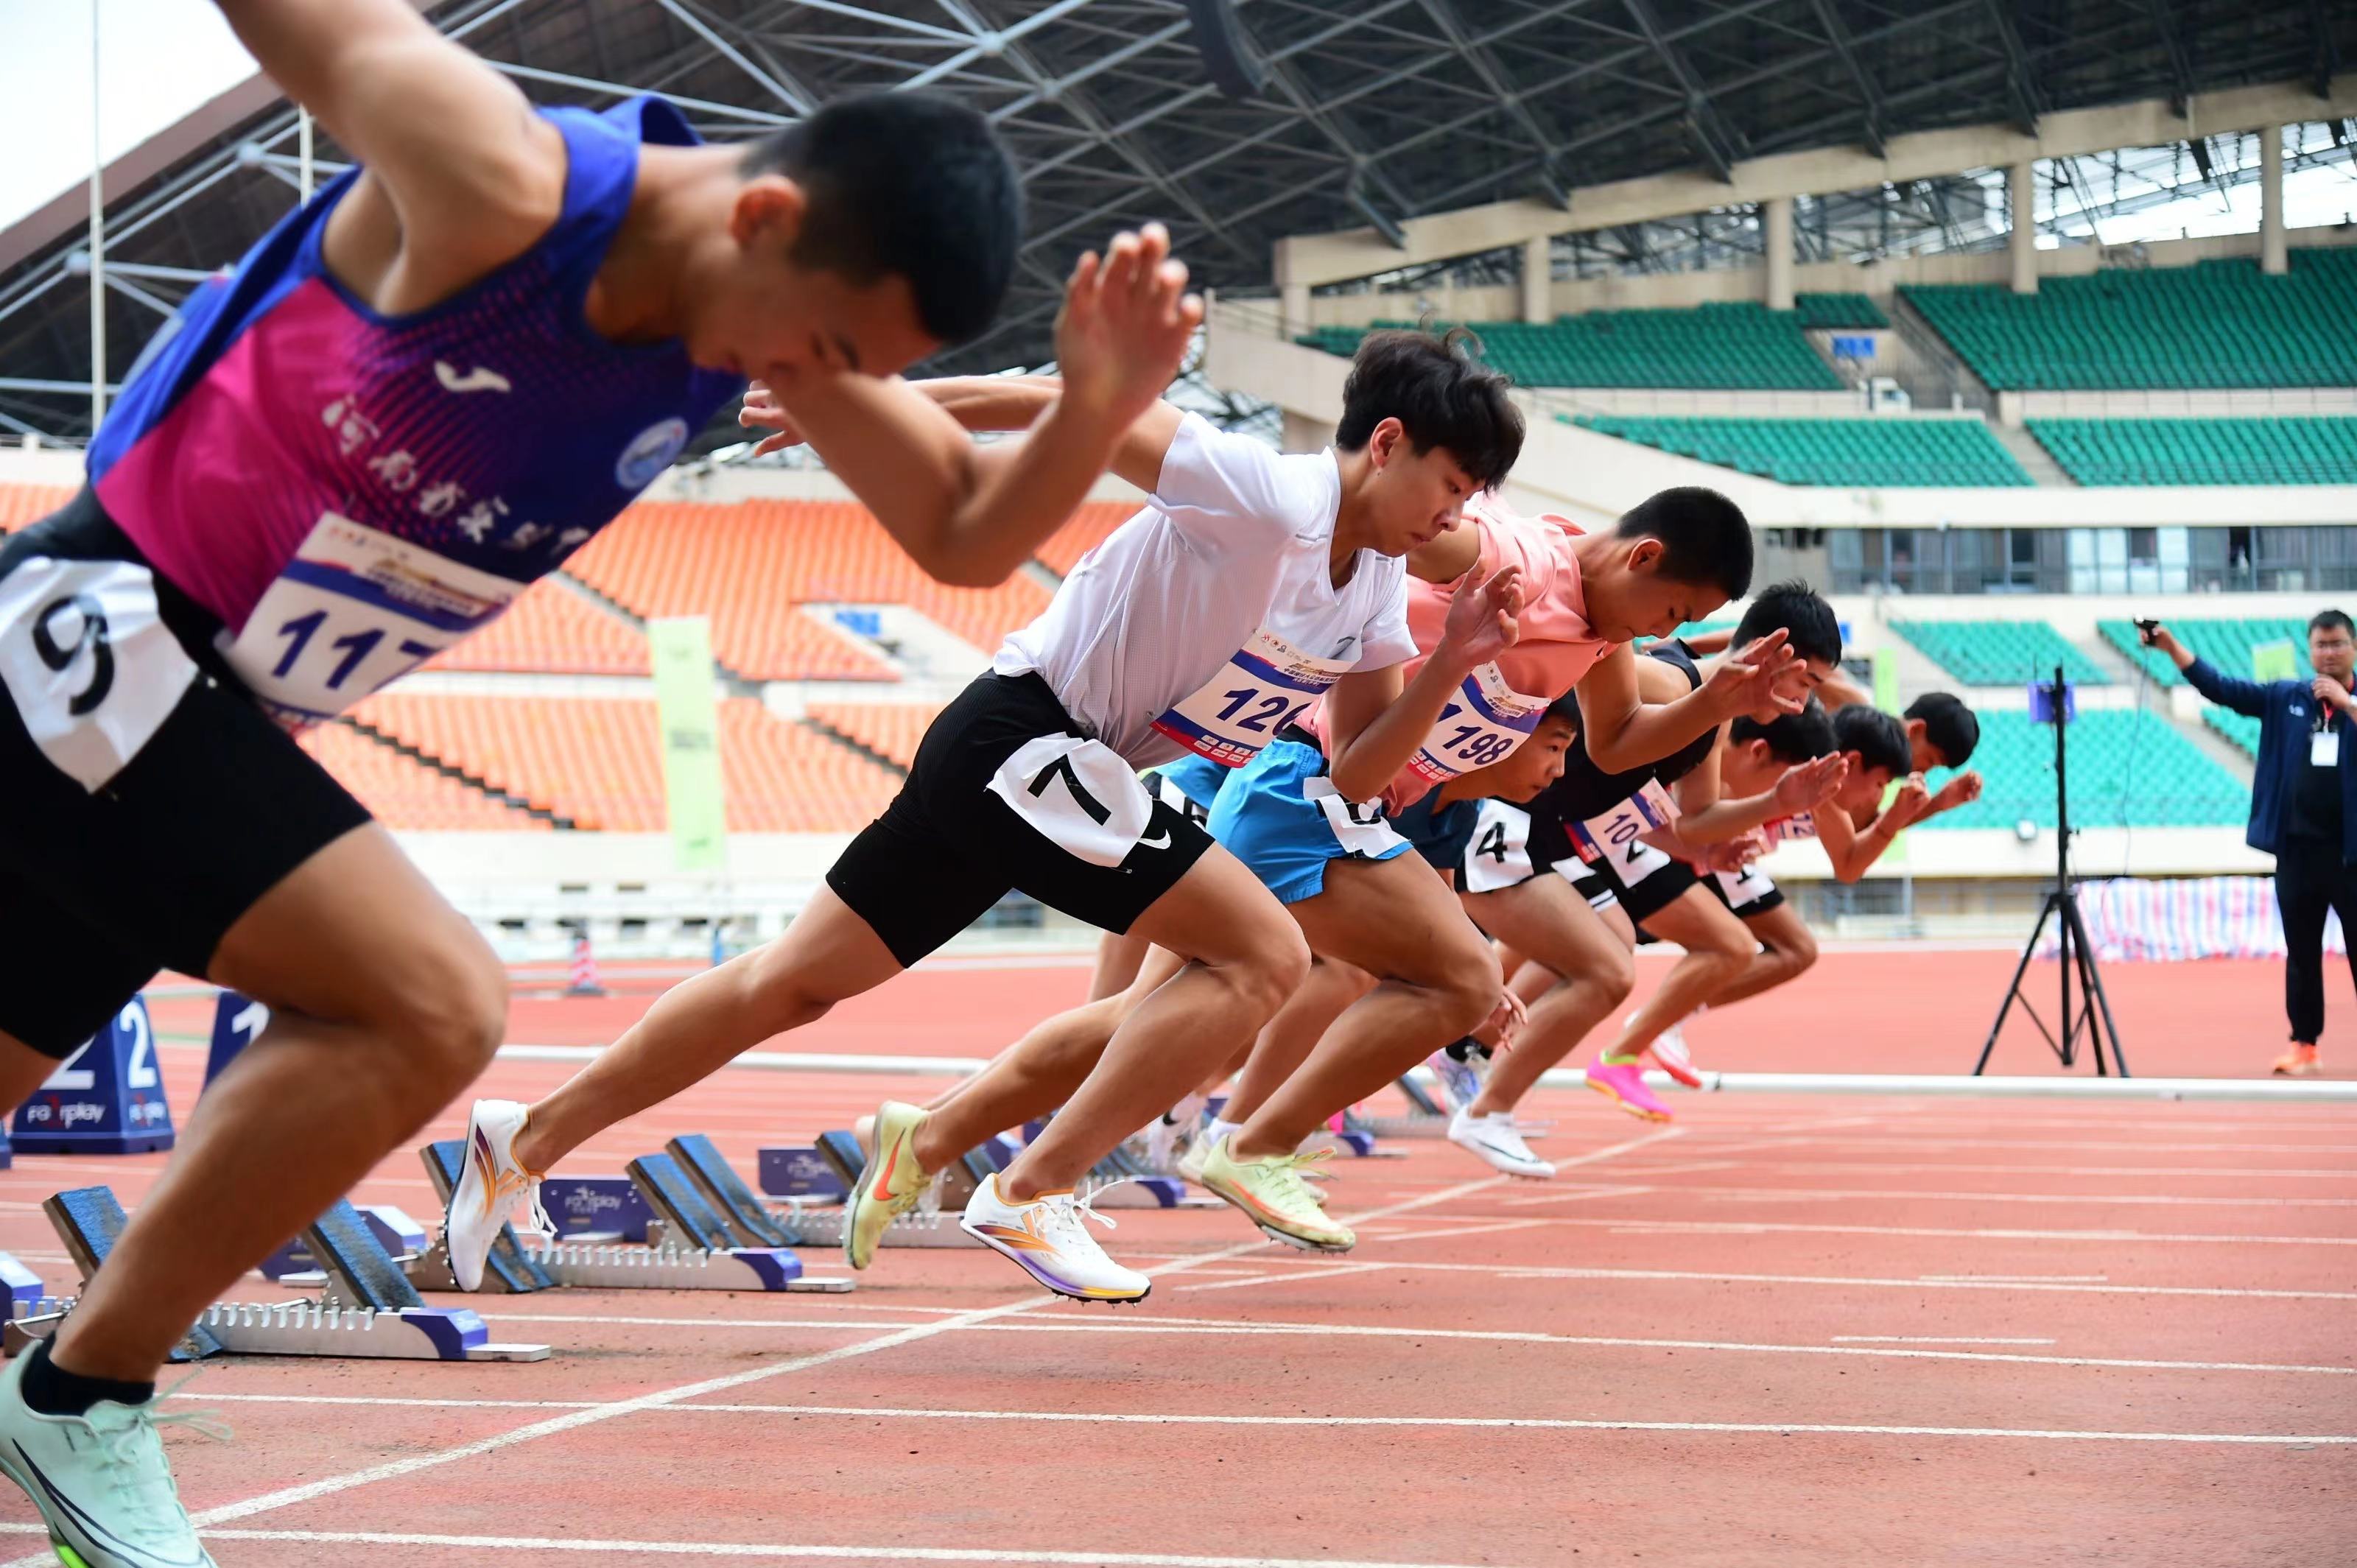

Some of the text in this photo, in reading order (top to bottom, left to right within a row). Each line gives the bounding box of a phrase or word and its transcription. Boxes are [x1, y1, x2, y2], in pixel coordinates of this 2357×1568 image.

[33, 594, 115, 716] 9
[1027, 753, 1112, 826] 7
[1475, 821, 1508, 864] 4
[119, 1001, 157, 1089] 2
